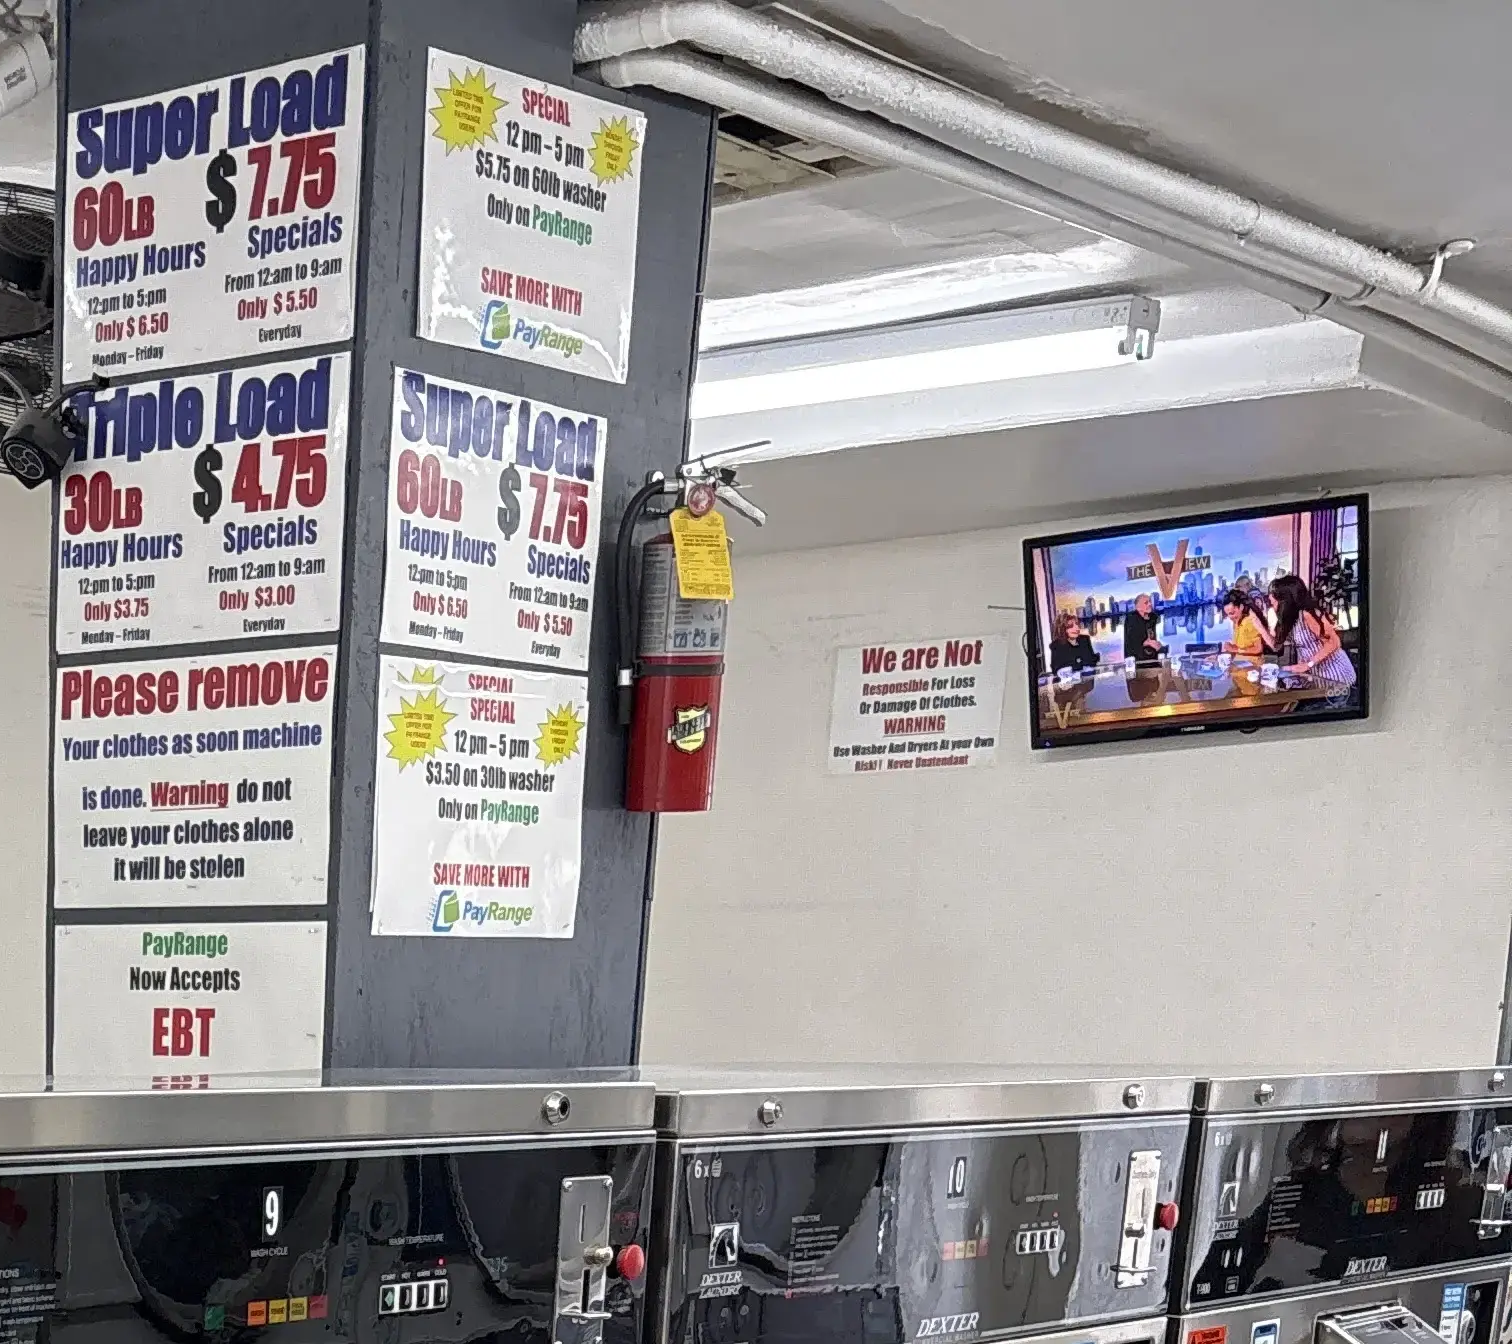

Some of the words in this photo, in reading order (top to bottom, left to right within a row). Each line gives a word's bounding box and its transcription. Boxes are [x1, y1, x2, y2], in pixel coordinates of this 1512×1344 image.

[76, 88, 220, 179] Super
[228, 53, 350, 149] Load
[522, 88, 571, 126] SPECIAL
[205, 149, 238, 234] $
[247, 132, 337, 221] 7.75
[475, 150, 510, 183] $5.75
[514, 165, 529, 188] on
[532, 166, 559, 193] 60lb
[563, 182, 607, 213] washer
[73, 181, 155, 252] 60LB
[248, 212, 343, 259] Specials
[487, 193, 512, 226] Only
[516, 205, 530, 227] on
[533, 204, 592, 246] PayRange
[76, 252, 138, 288] Happy
[143, 241, 206, 277] Hours
[225, 272, 255, 293] From
[258, 267, 293, 286] 12:am
[295, 263, 307, 282] to
[310, 258, 342, 278] 9:am
[87, 296, 120, 316] 12:pm
[122, 292, 134, 310] to
[137, 288, 167, 307] 5:pm
[237, 298, 267, 322] Only
[274, 292, 283, 314] $
[286, 287, 318, 311] 5.50
[481, 267, 512, 297] SAVE
[516, 277, 549, 307] MORE
[552, 287, 582, 317] WITH
[95, 319, 124, 344] Only
[127, 316, 135, 338] $
[138, 312, 168, 337] 6.50
[513, 319, 583, 358] PayRange
[69, 379, 204, 463] Triple
[214, 357, 332, 444] Load
[400, 370, 513, 461] Super
[515, 400, 598, 482] Load
[193, 444, 223, 524] $
[231, 434, 328, 513] 4.75
[396, 449, 463, 523] 60LB
[64, 471, 143, 535] 30LB
[497, 462, 522, 541] $
[528, 473, 589, 550] 7.75
[61, 538, 118, 569] Happy
[123, 533, 183, 563] Hours
[223, 515, 318, 554] Specials
[399, 519, 450, 563] Happy
[452, 530, 497, 568] Hours
[527, 544, 590, 585] Specials
[1130, 563, 1153, 579] THE
[862, 647, 897, 674] We
[902, 646, 939, 671] are
[944, 640, 983, 668] Not
[61, 669, 179, 720] Please
[188, 657, 329, 711] remove
[860, 702, 871, 715] Or
[873, 699, 917, 714] Damage
[919, 697, 931, 710] Of
[933, 694, 977, 710] Clothes.
[862, 679, 929, 696] Responsible
[931, 677, 949, 691] For
[950, 676, 975, 689] Loss
[470, 698, 515, 724] SPECIAL
[883, 715, 945, 735] WARNING
[62, 737, 100, 761] Your
[103, 732, 168, 757] clothes
[172, 734, 192, 755] as
[196, 730, 238, 753] soon
[243, 722, 322, 750] machine
[82, 787, 98, 810] is
[101, 786, 147, 809] done.
[150, 780, 229, 808] Warning
[237, 779, 258, 803] do
[262, 778, 292, 801] not
[426, 761, 460, 787] $3.50
[463, 767, 477, 787] on
[481, 762, 505, 790] 30lb
[509, 769, 555, 793] washer
[83, 824, 127, 848] leave
[131, 824, 170, 848] your
[174, 819, 239, 844] clothes
[243, 817, 293, 842] alone
[114, 858, 126, 881] it
[129, 856, 160, 880] will
[164, 856, 186, 879] be
[190, 854, 245, 880] stolen
[433, 862, 461, 886] SAVE
[464, 864, 495, 887] MORE
[498, 866, 530, 888] WITH
[463, 901, 533, 925] PayRange
[142, 931, 228, 958] PayRange
[129, 967, 166, 991] Now
[170, 967, 240, 993] Accepts
[152, 1008, 216, 1057] EBT
[947, 1159, 965, 1198] 10
[265, 1190, 279, 1236] 9
[916, 1312, 979, 1338] DEXTER
